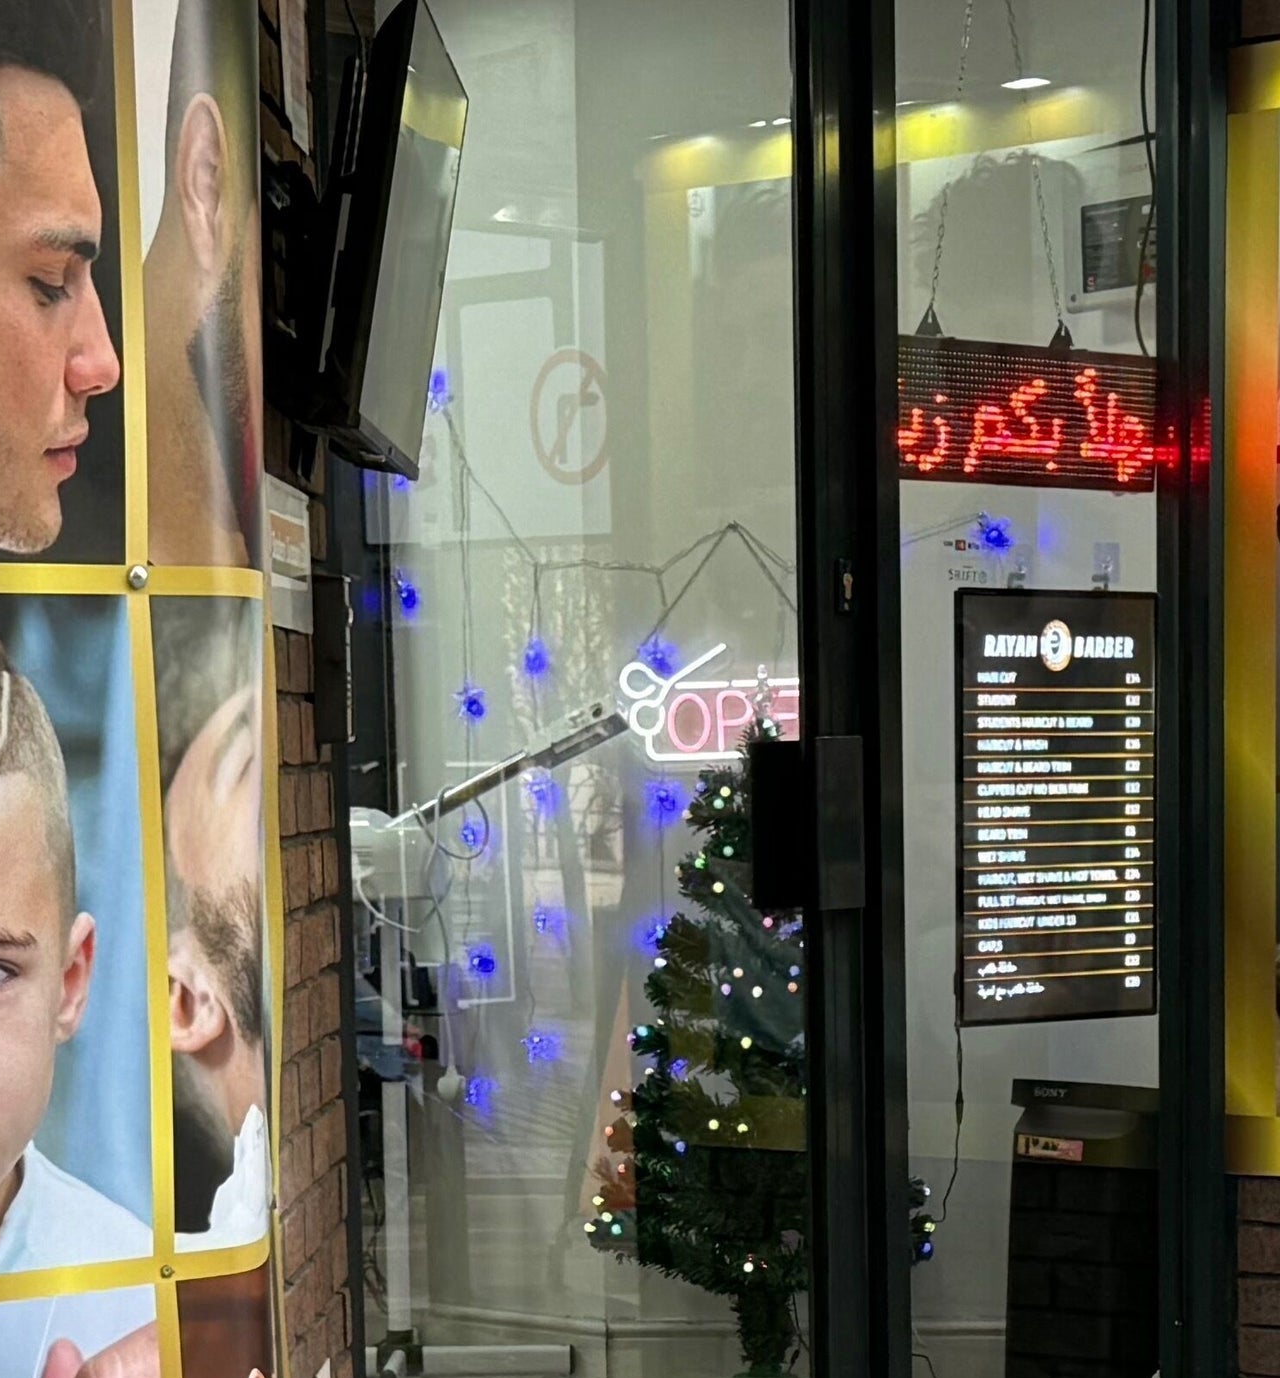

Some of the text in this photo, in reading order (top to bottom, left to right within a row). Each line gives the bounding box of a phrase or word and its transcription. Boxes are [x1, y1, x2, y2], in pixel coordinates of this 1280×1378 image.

[984, 634, 1134, 658] RAYAN BARBER
[1033, 1087, 1068, 1098] SONY
